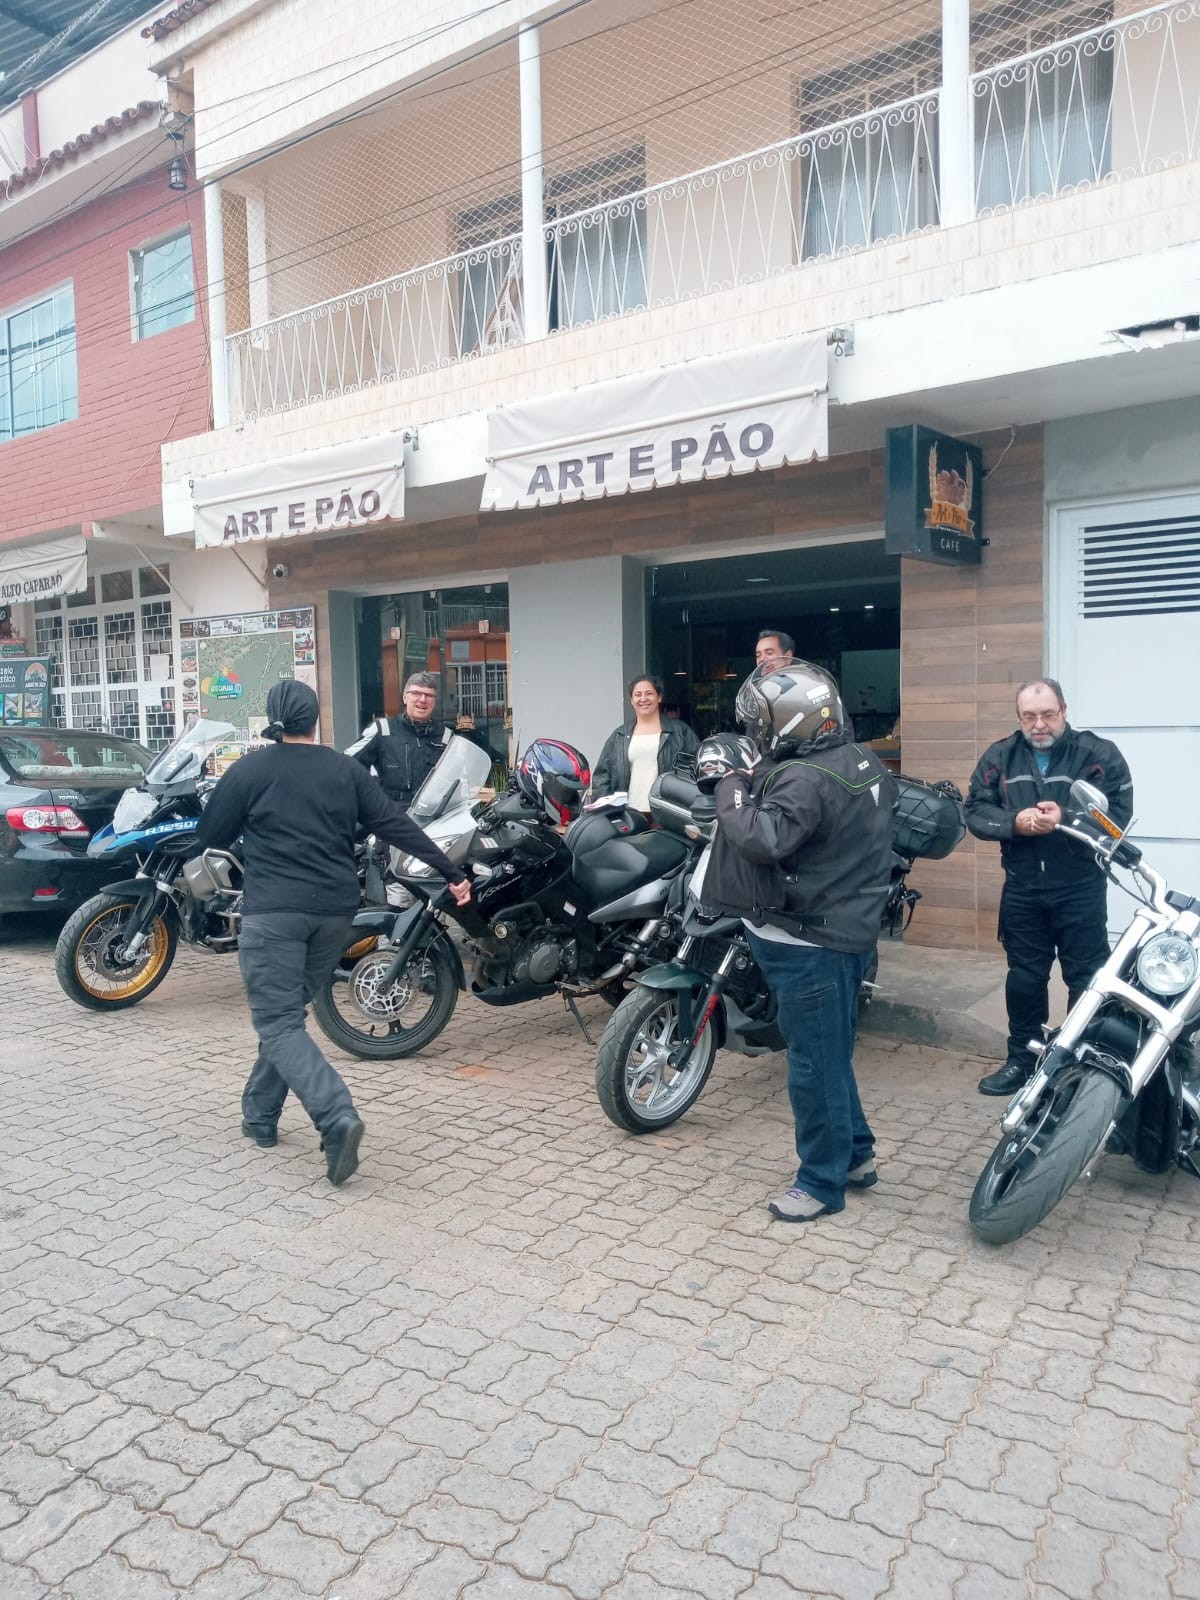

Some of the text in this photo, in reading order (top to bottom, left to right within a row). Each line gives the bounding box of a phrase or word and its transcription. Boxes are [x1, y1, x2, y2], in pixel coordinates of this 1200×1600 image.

[527, 422, 774, 496] ART E PÃO
[223, 487, 381, 541] ART E PÃO
[1, 570, 63, 598] ALTO CAPARAÓ
